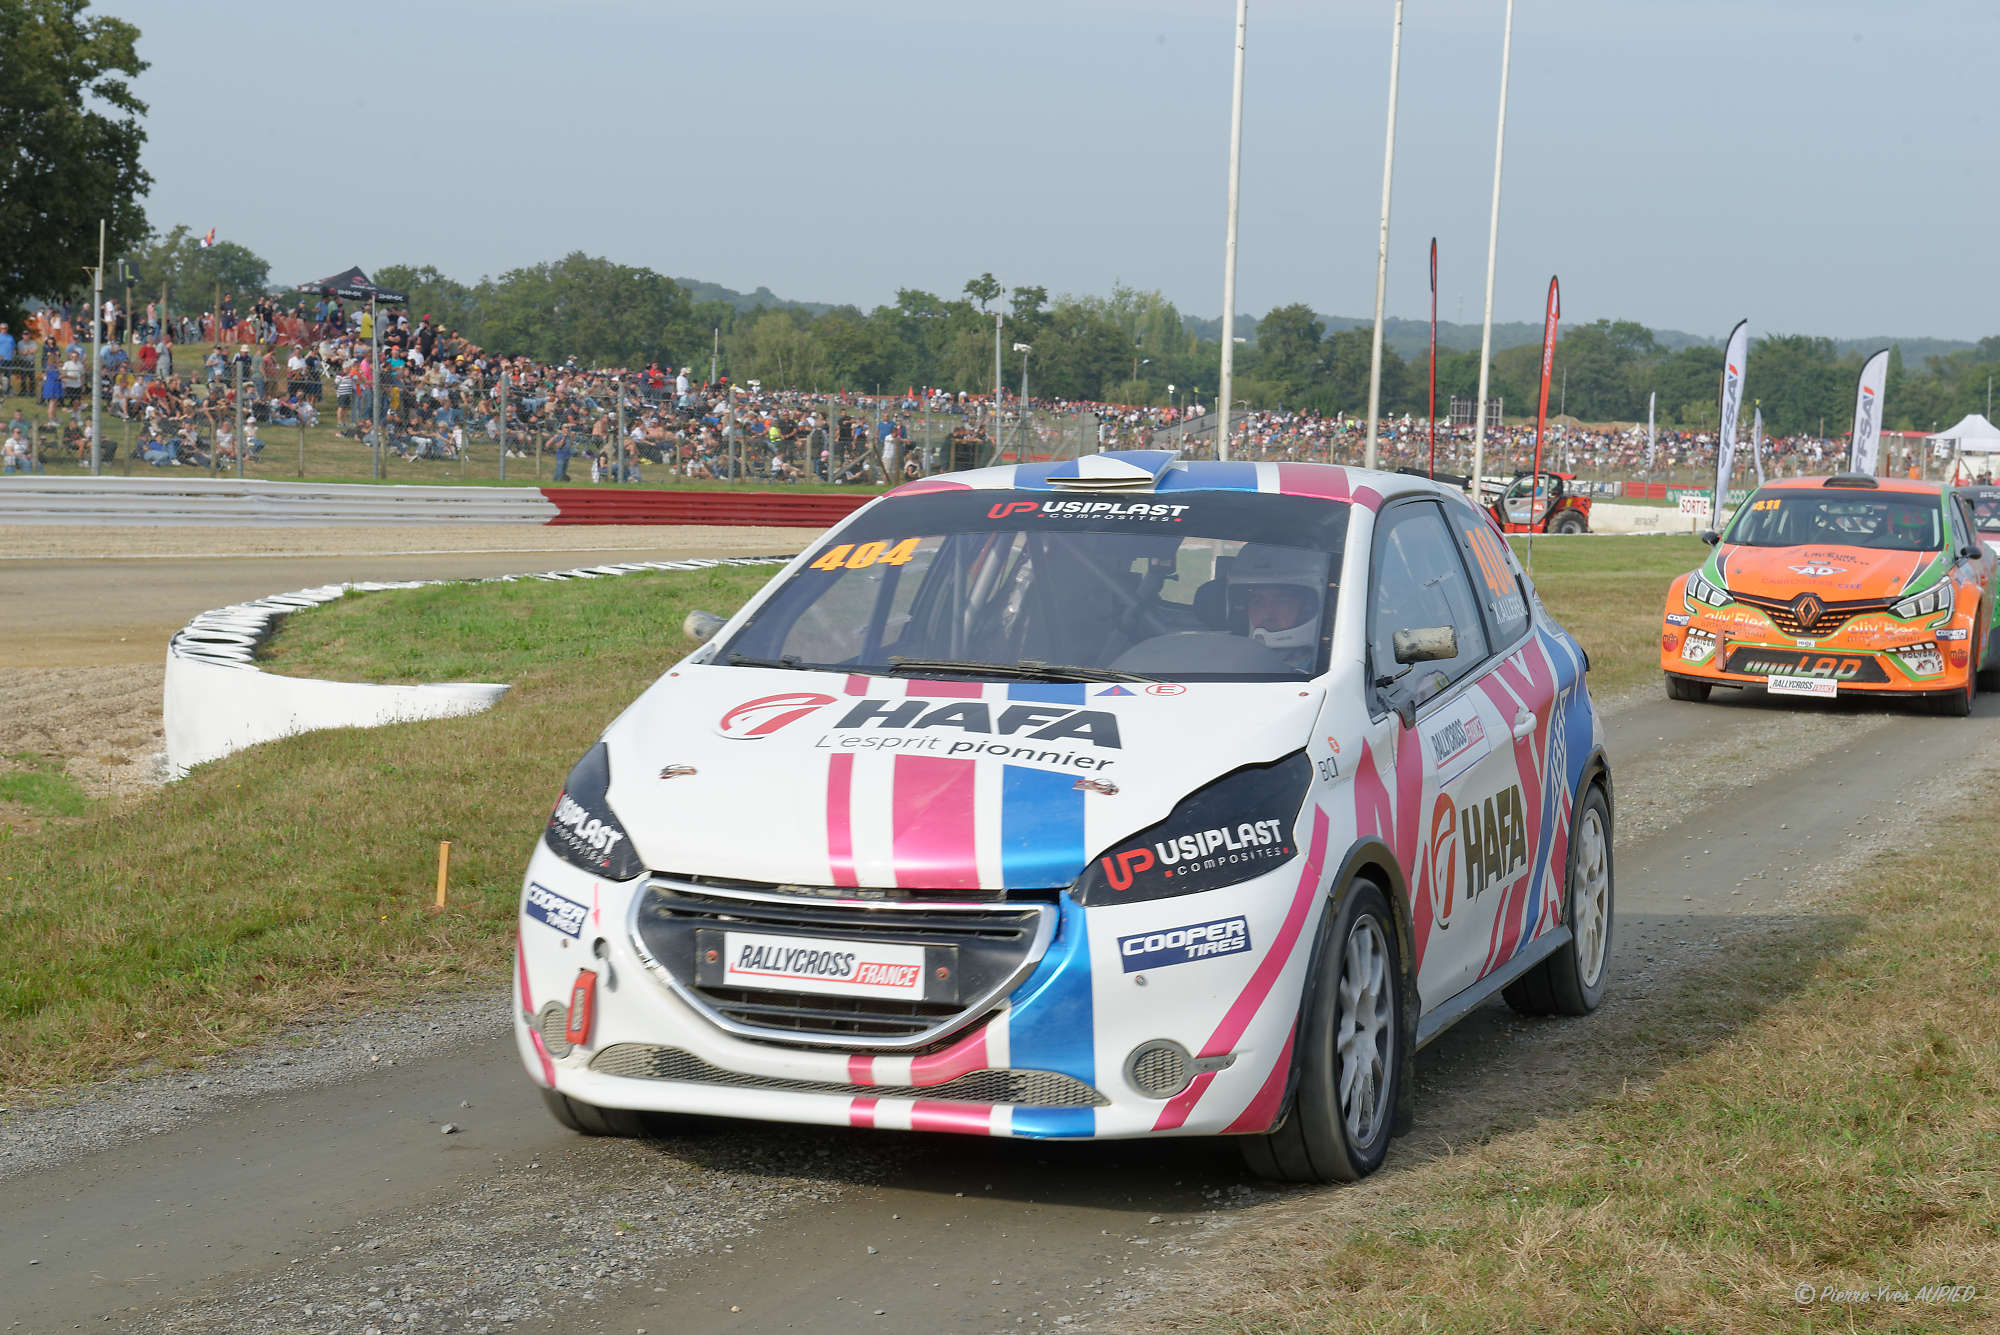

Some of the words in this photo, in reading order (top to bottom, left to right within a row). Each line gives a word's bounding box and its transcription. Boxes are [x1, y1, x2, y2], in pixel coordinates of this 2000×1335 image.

[1855, 398, 1874, 473] FFSA
[1042, 501, 1189, 517] USIPLAST
[1049, 513, 1169, 522] COMPOSITES
[1681, 499, 1708, 516] SORTIE
[1752, 500, 1782, 511] 411
[809, 538, 922, 571] 404
[1797, 566, 1835, 576] AD
[1792, 656, 1862, 679] LAD
[1772, 679, 1813, 690] RALLYCROSS
[833, 699, 1122, 750] HAFA
[1431, 718, 1467, 762] RALLYCROSS
[814, 734, 941, 752] L'esprit
[947, 740, 1116, 771] pionnier
[1154, 819, 1282, 866] USIPLAST
[1461, 785, 1527, 900] HAFA
[1177, 847, 1281, 876] COMPOSITES
[528, 884, 587, 922] COOPER
[1122, 919, 1245, 956] COOPER
[1184, 936, 1246, 958] TIRES
[738, 944, 856, 976] RALLYCROSS
[856, 964, 919, 986] FRANCE
